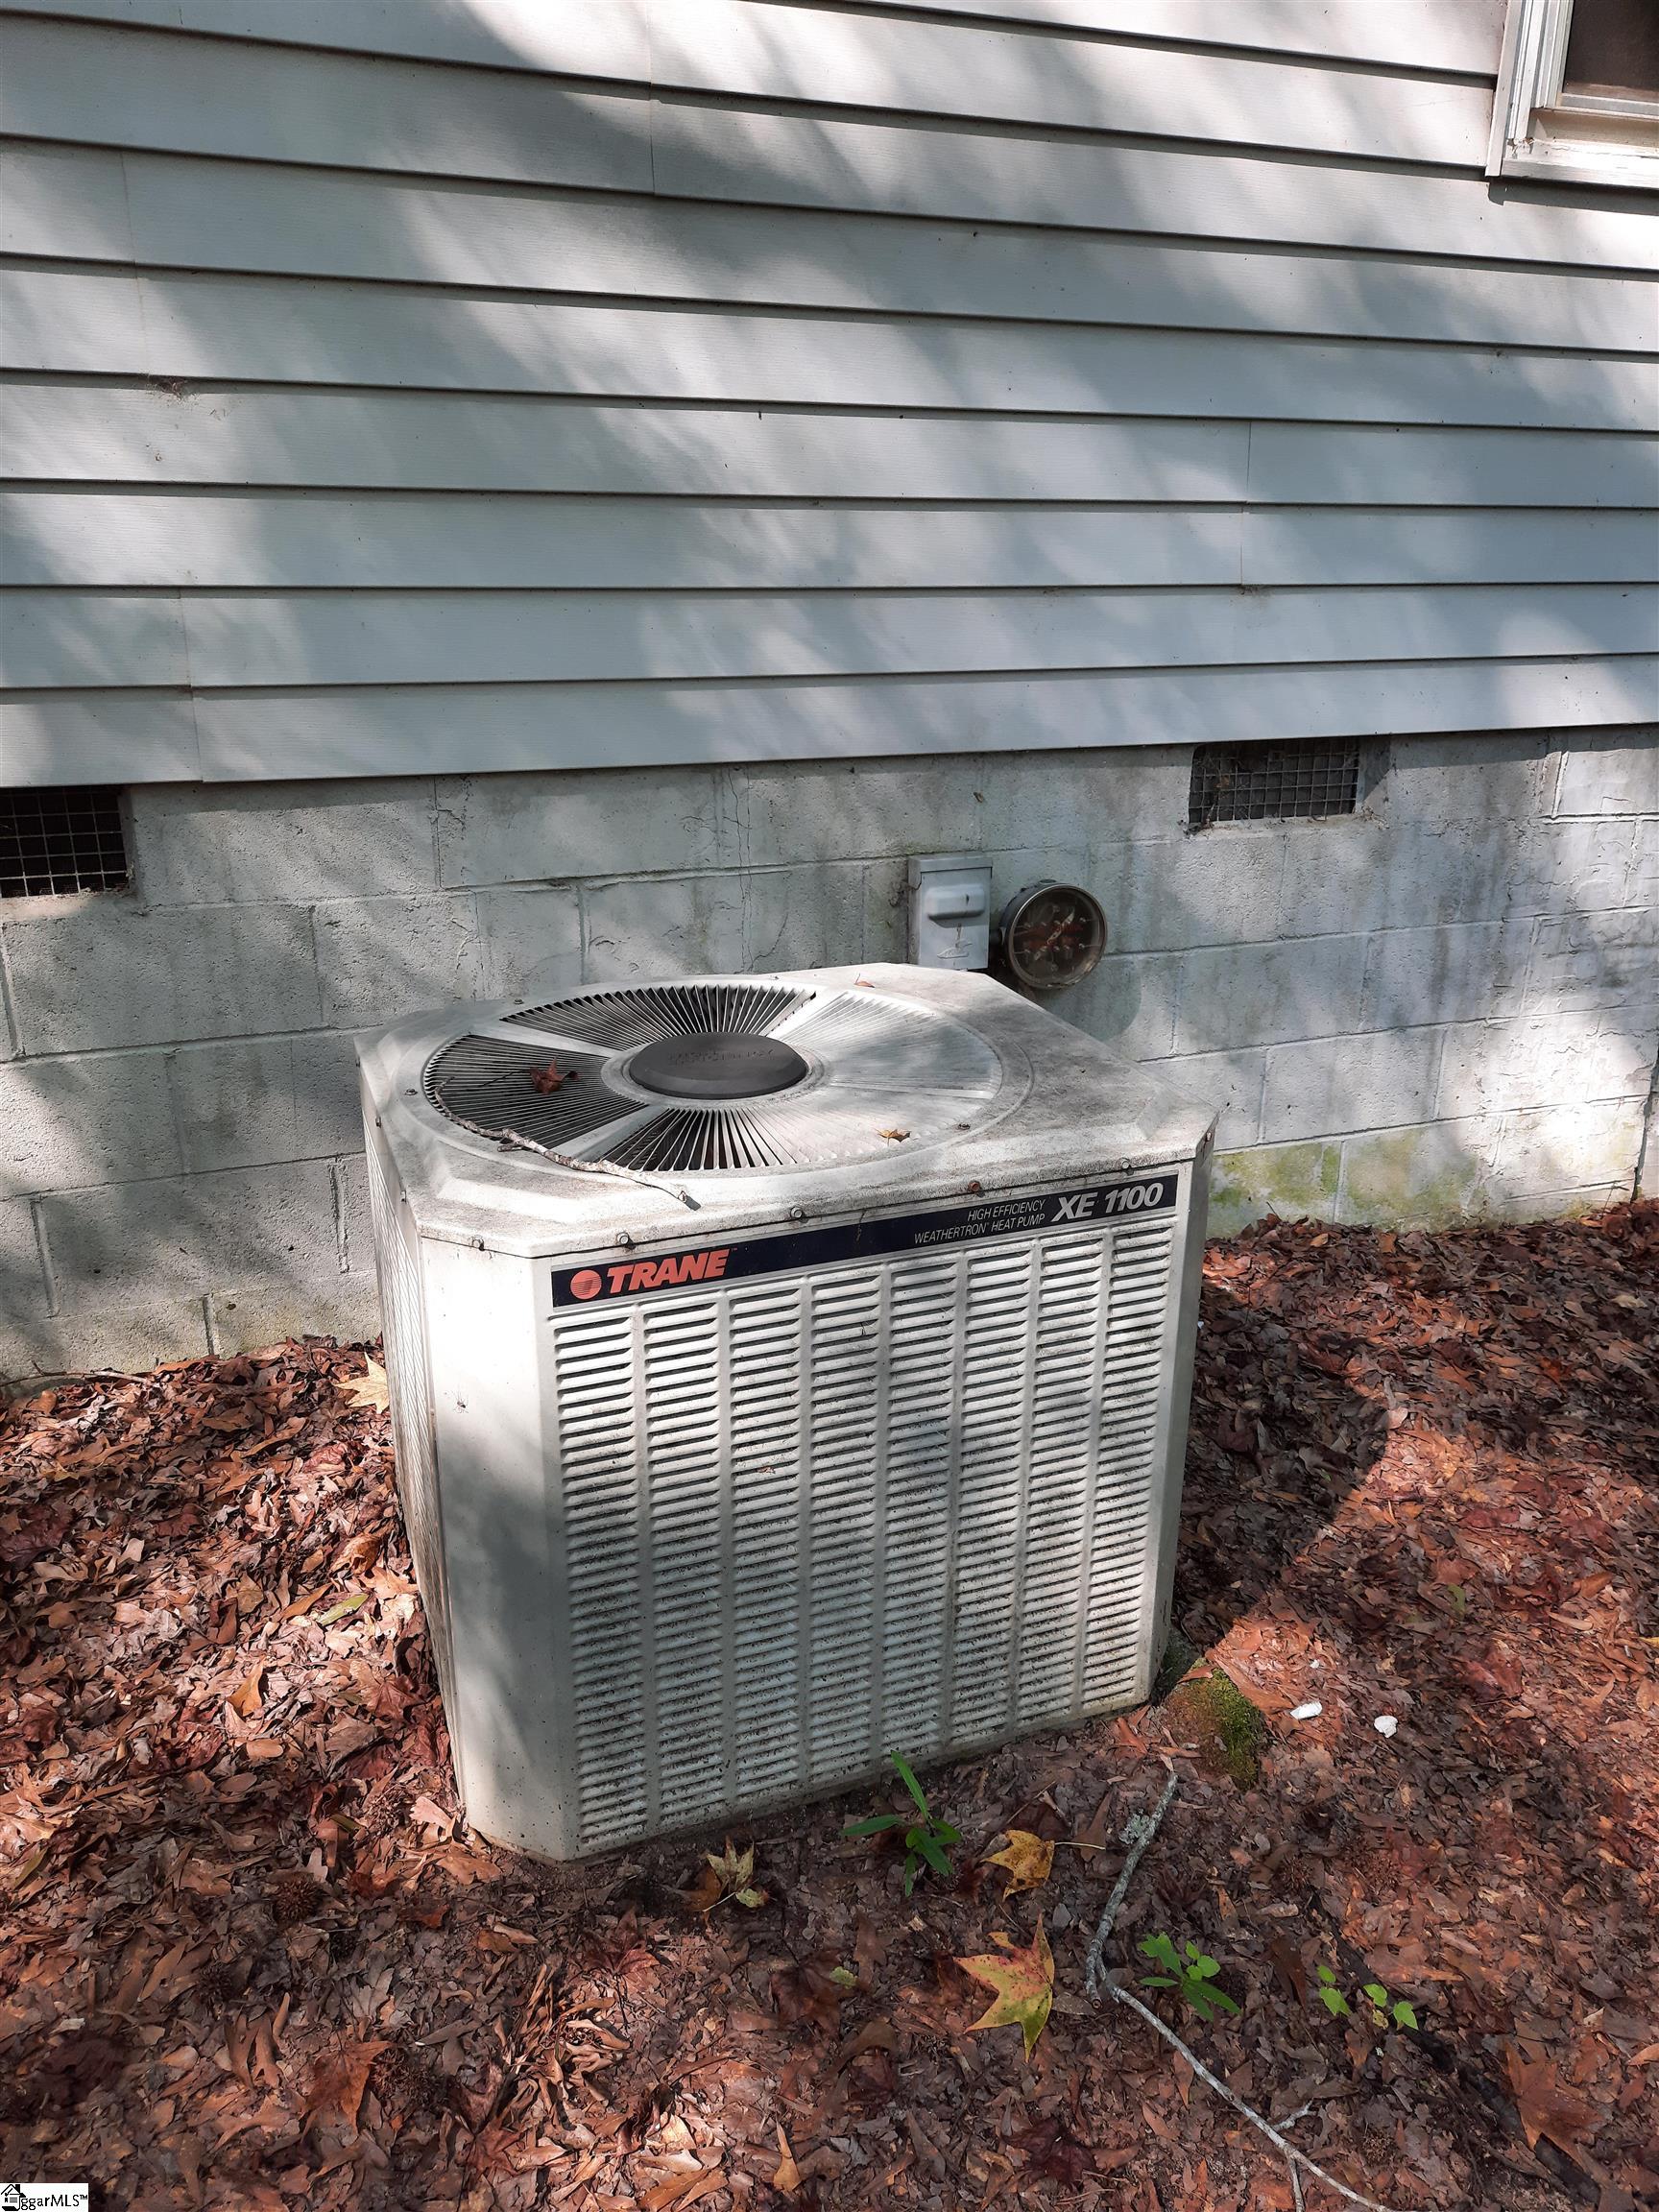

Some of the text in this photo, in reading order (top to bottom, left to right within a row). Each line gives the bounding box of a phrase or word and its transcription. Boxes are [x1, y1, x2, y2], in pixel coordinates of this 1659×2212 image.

[967, 1199, 1046, 1221] HIGH EFFICIENCY
[1051, 1183, 1164, 1222] XE 1100
[991, 1217, 1017, 1232] HEAT
[1018, 1213, 1046, 1228] PUMP
[607, 1249, 730, 1294] TRANE
